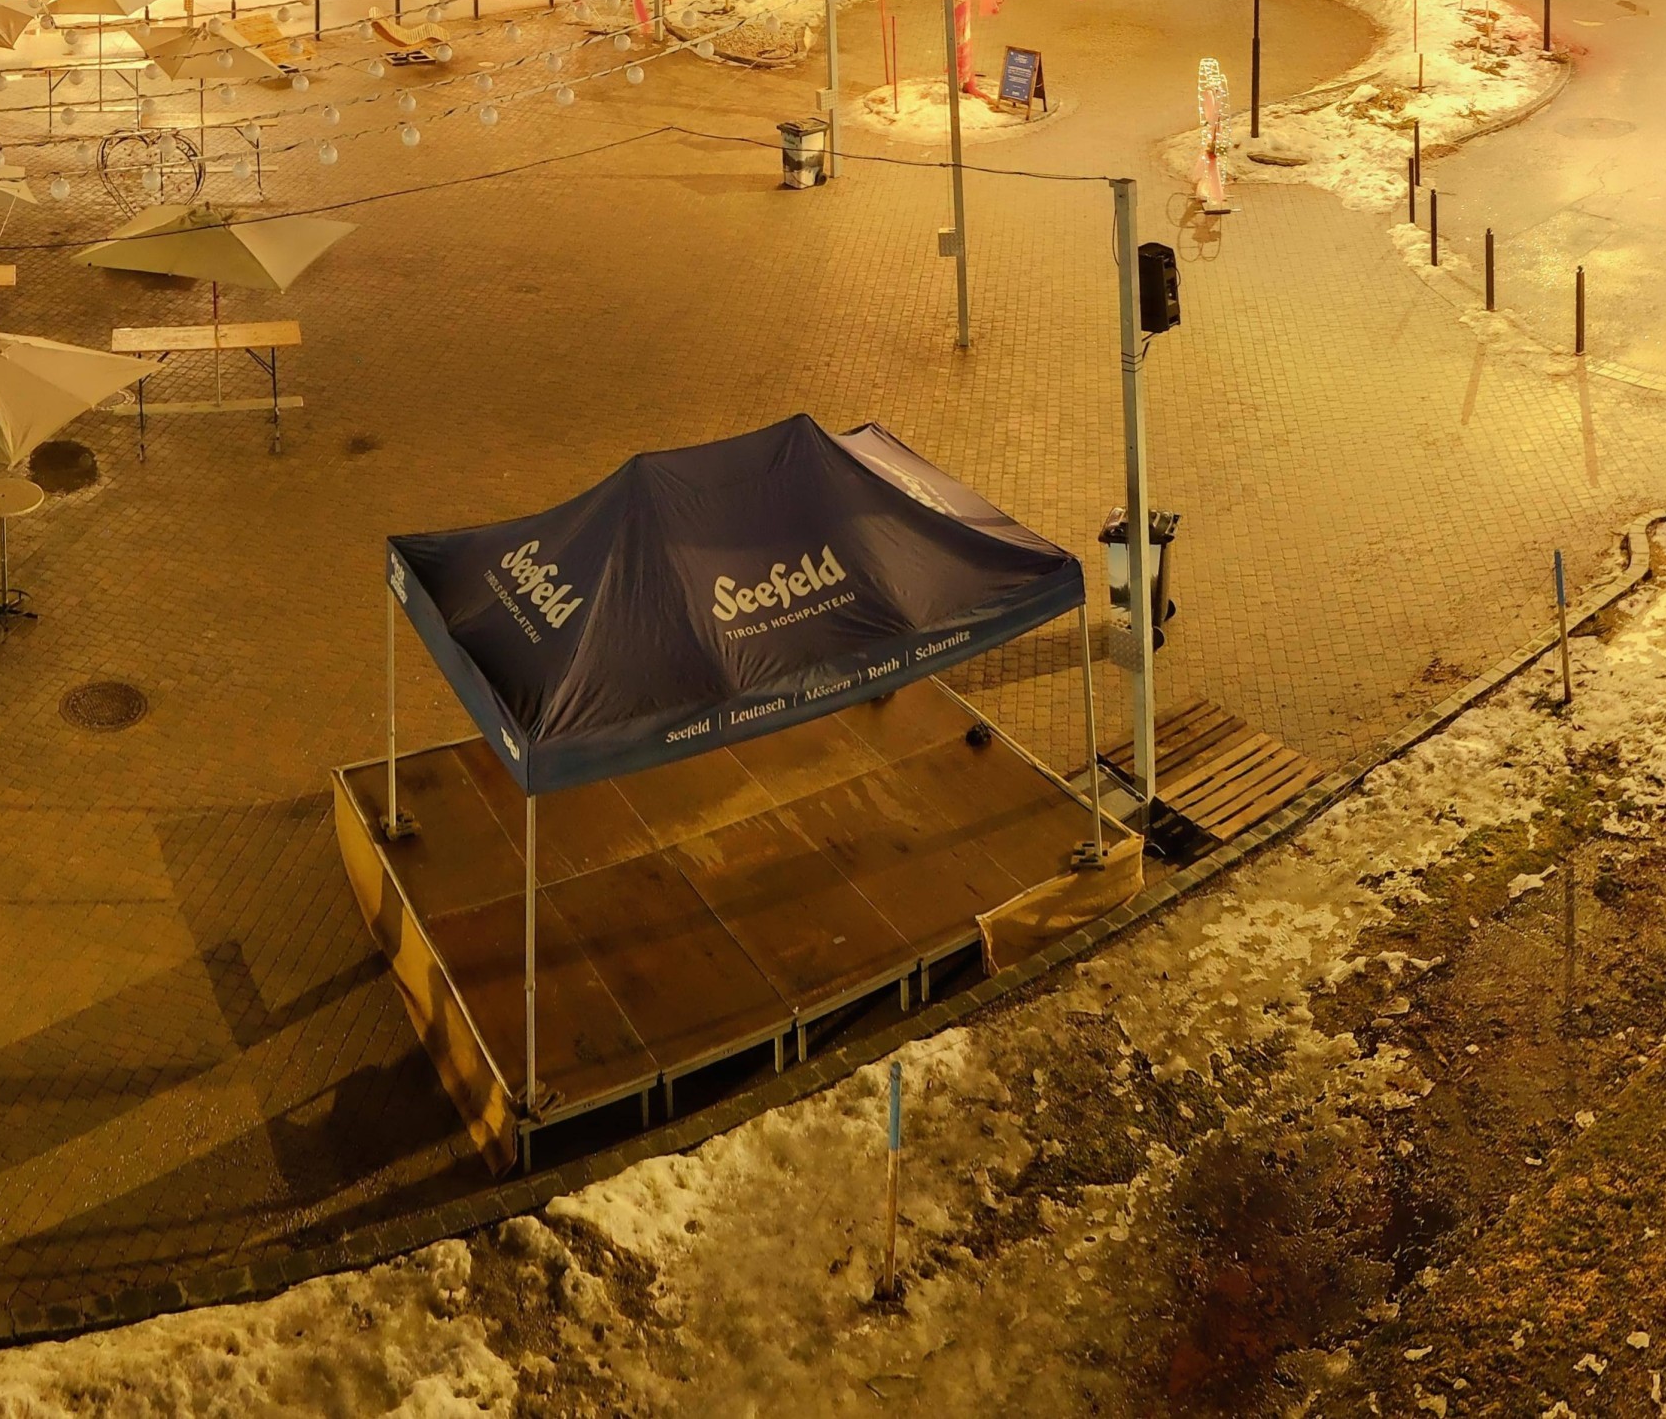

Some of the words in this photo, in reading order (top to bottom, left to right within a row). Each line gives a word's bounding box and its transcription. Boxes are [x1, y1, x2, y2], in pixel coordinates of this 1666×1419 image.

[501, 540, 583, 629] Seefeld
[712, 544, 847, 622] Seefeld
[725, 622, 768, 641] TIROLS
[771, 591, 856, 628] HOCHPLATEAU
[666, 718, 711, 743] Seefeld
[730, 698, 786, 725] Leutasch
[867, 657, 900, 680] Reith
[915, 630, 971, 661] Scharnitz
